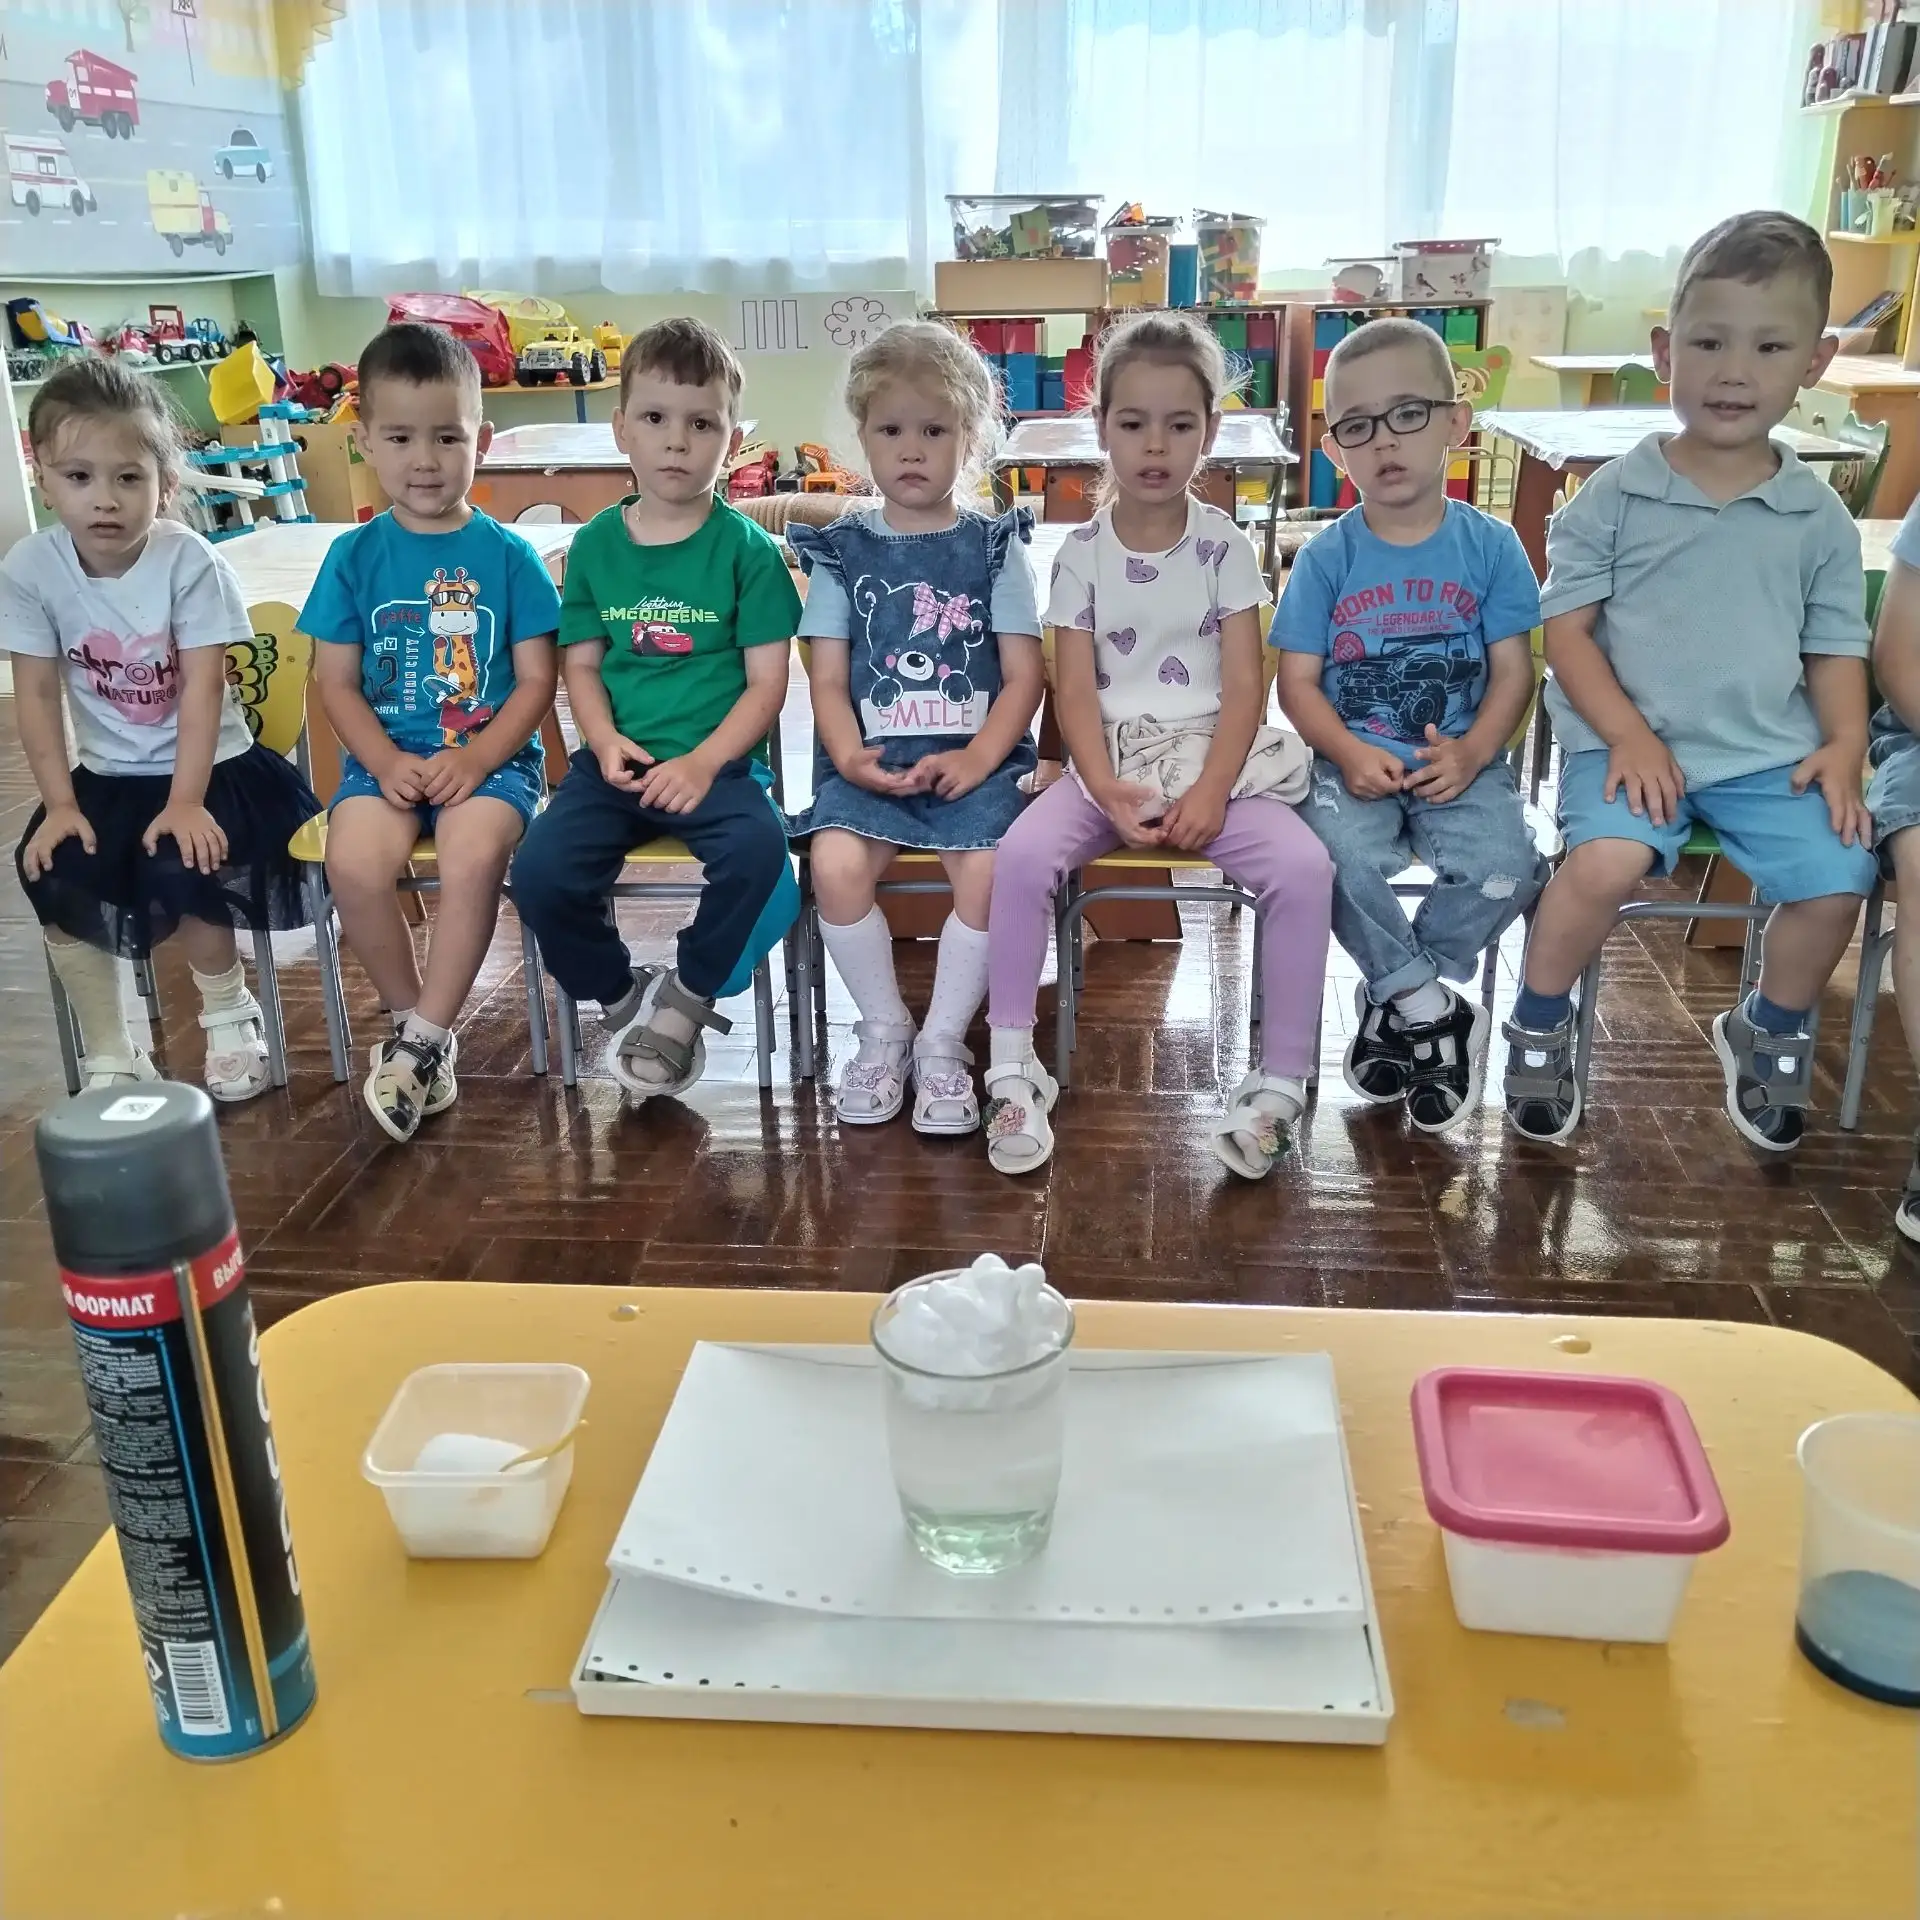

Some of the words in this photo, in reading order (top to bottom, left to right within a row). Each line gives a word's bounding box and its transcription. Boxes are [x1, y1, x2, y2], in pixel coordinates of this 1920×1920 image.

[1333, 583, 1394, 626] BORN
[1403, 578, 1434, 602] TO
[1376, 610, 1444, 627] LEGENDARY
[405, 638, 420, 668] CITY
[878, 699, 973, 729] SMILE
[74, 1293, 155, 1318] ФОРМАТ
